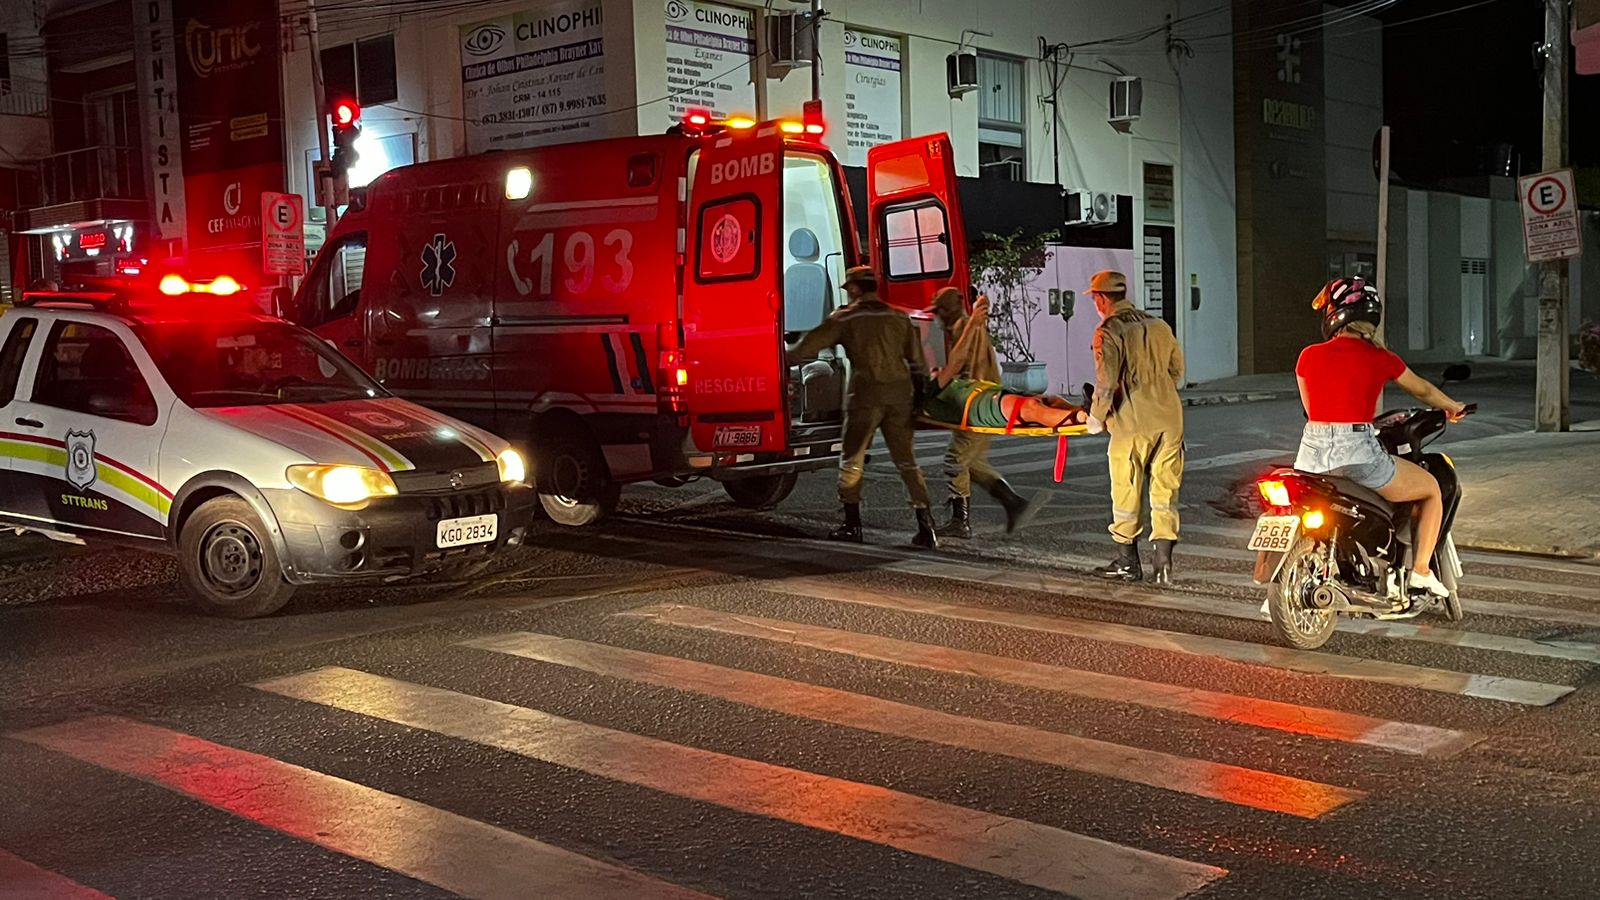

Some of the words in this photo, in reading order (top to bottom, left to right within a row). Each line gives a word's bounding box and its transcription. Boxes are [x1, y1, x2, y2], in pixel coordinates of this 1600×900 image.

[516, 8, 603, 41] CLINOPHI
[148, 1, 173, 223] DENTISTA
[711, 152, 775, 185] BOMB
[1540, 185, 1554, 205] E
[278, 205, 288, 223] E
[208, 218, 224, 234] CEF
[531, 228, 634, 295] 193
[695, 376, 767, 394] RESGATE
[61, 494, 108, 511] STTRANS
[466, 524, 493, 540] 2834
[1258, 525, 1292, 538] PGR
[1253, 536, 1290, 549] 0889
